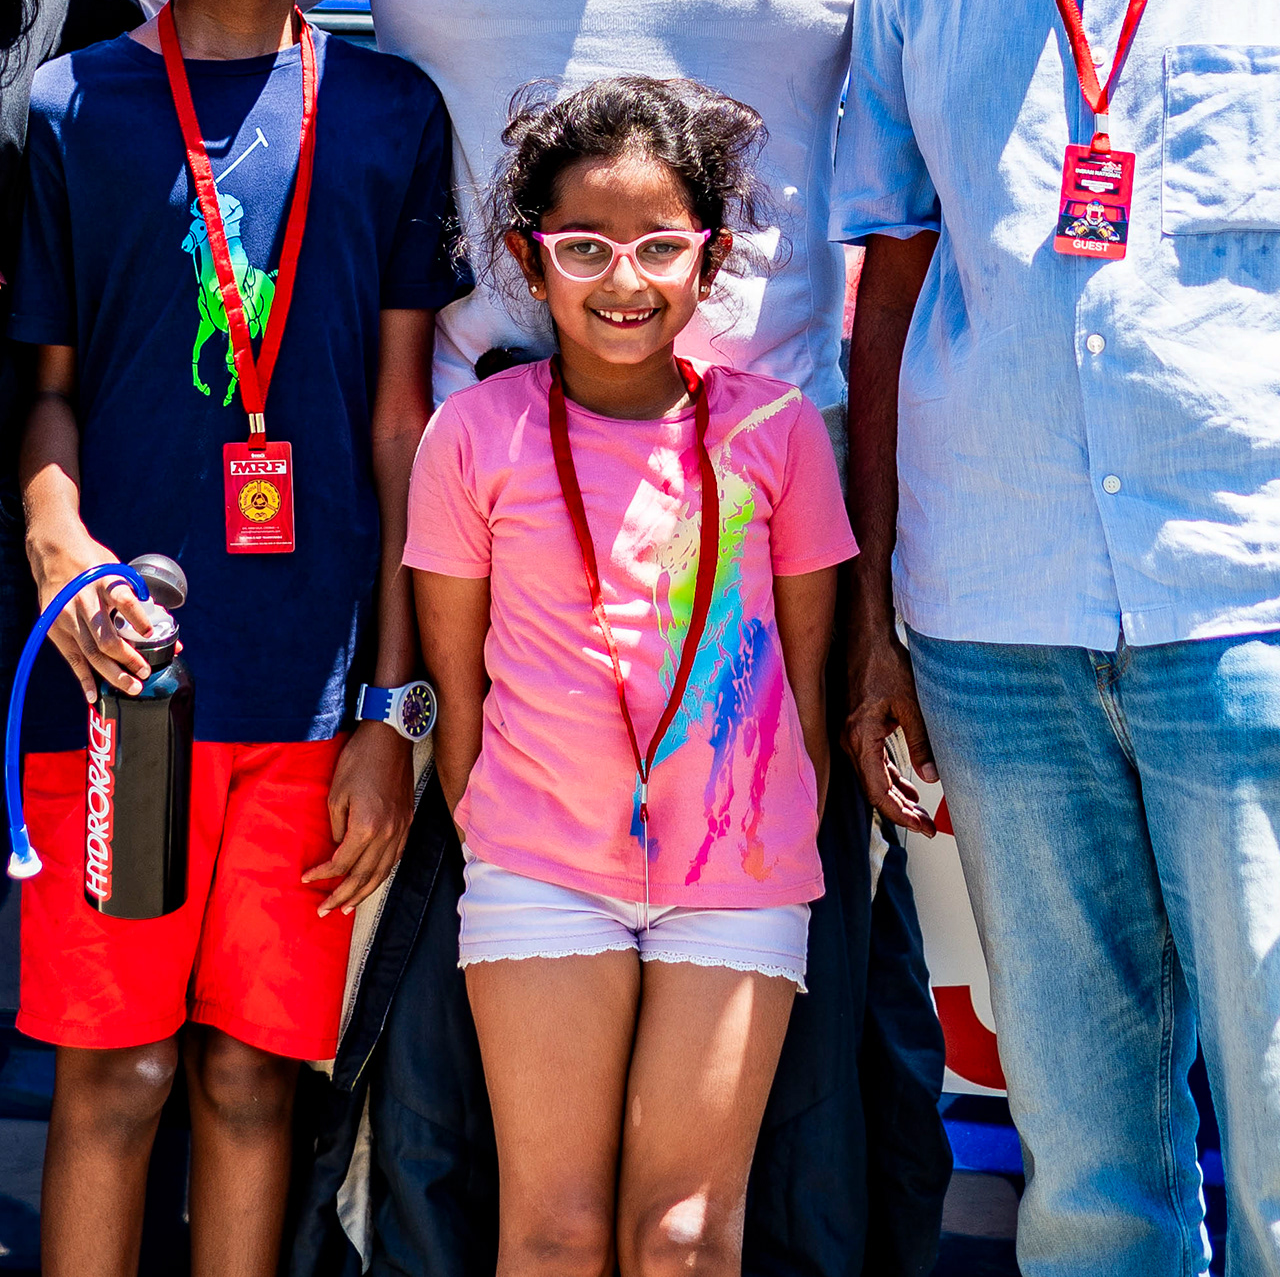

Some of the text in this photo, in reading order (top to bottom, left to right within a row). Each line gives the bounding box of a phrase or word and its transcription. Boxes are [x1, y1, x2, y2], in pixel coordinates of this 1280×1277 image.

[1072, 239, 1110, 252] GUEST
[231, 461, 286, 474] MRF
[85, 708, 113, 898] HYDRORACE
